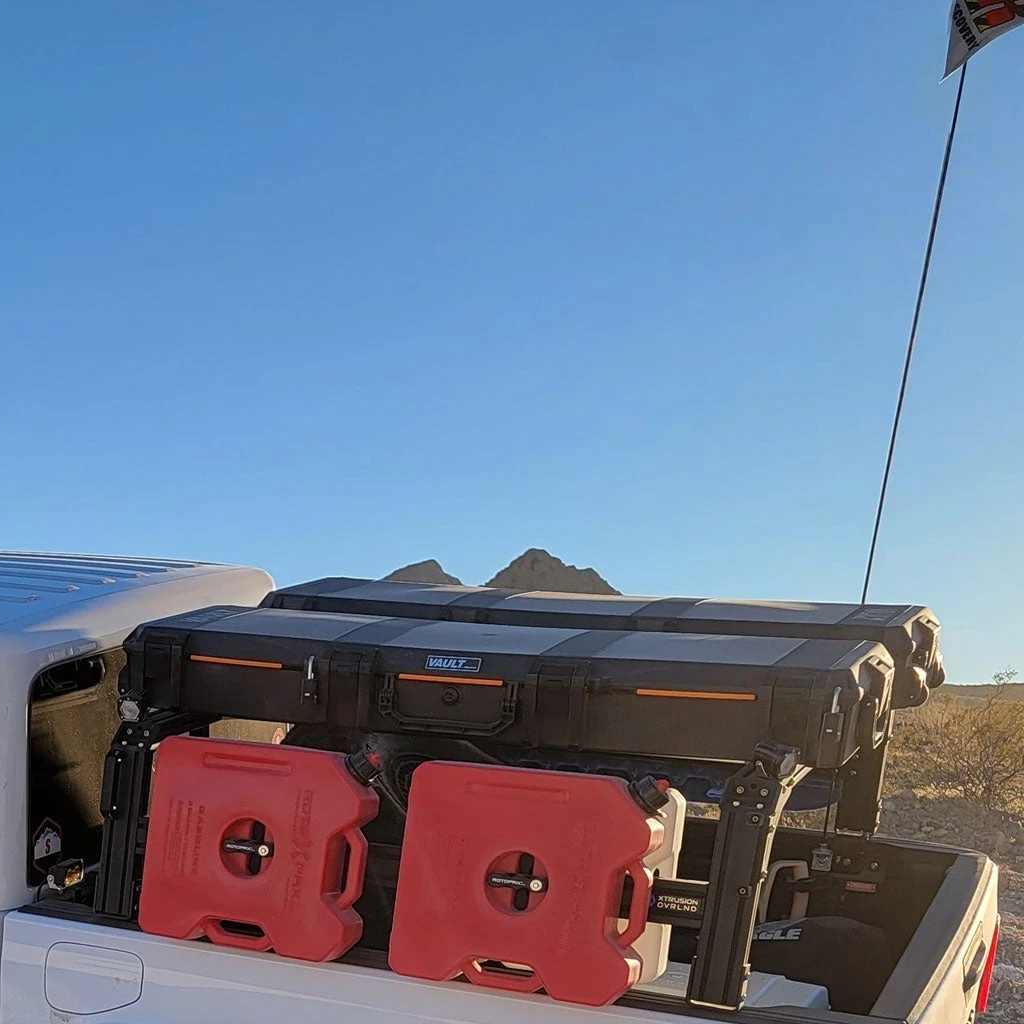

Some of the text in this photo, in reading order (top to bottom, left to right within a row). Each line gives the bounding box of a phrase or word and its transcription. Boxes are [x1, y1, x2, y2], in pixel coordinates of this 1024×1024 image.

[427, 657, 467, 669] VAULT
[45, 838, 51, 854] S
[657, 895, 699, 906] XTRUSION
[656, 901, 697, 913] OVRLND
